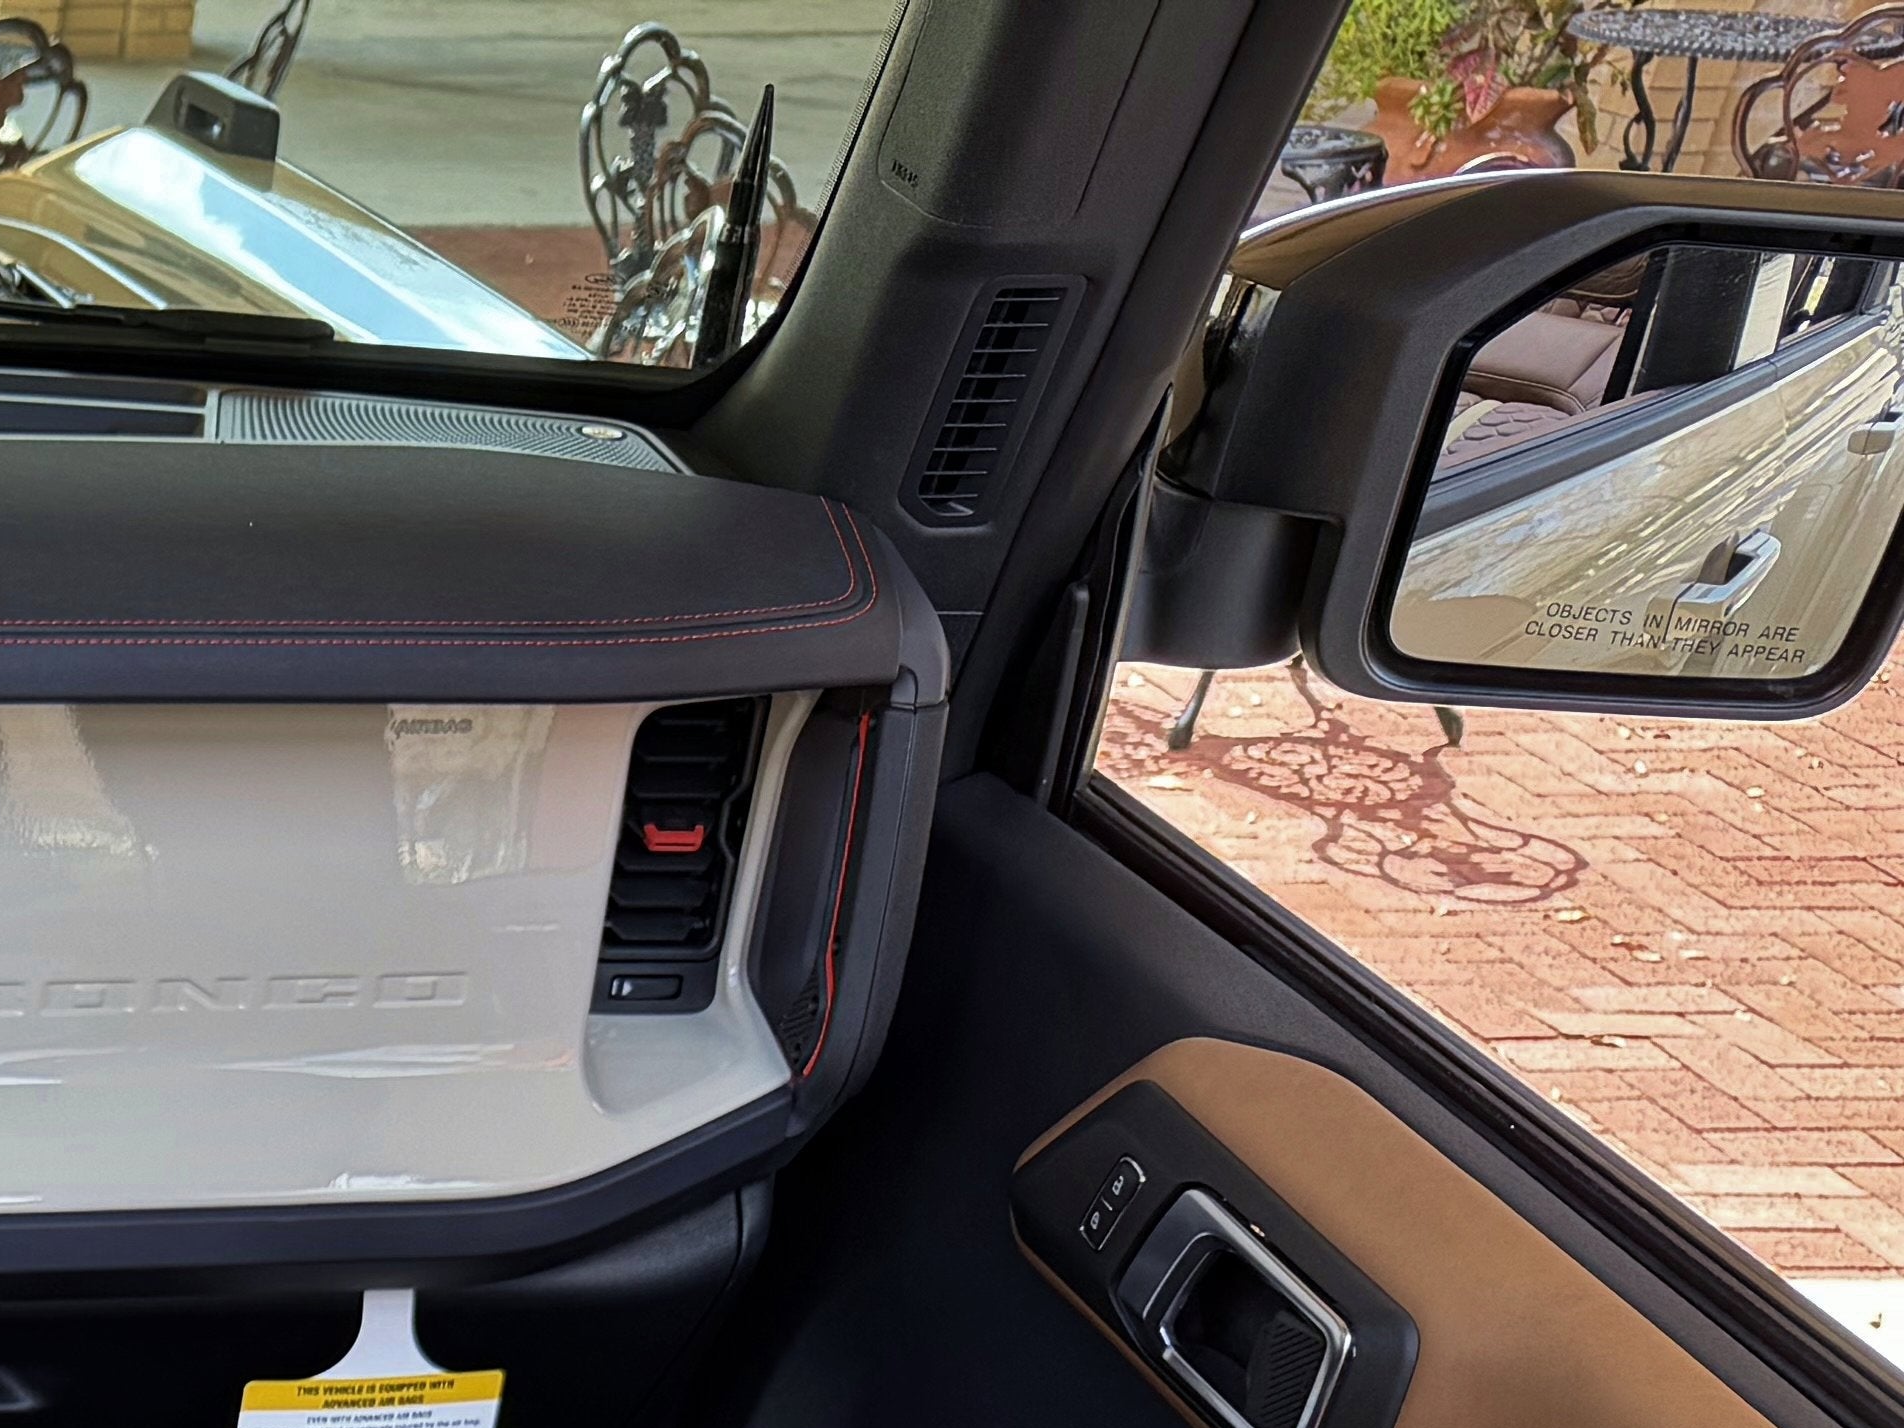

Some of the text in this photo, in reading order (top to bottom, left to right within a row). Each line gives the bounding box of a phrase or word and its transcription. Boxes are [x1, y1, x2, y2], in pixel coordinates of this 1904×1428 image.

[1524, 620, 1805, 664] CLOSER THAN THEY APPEAR
[1545, 602, 1800, 643] OBJECTS IN MIRROR ARE
